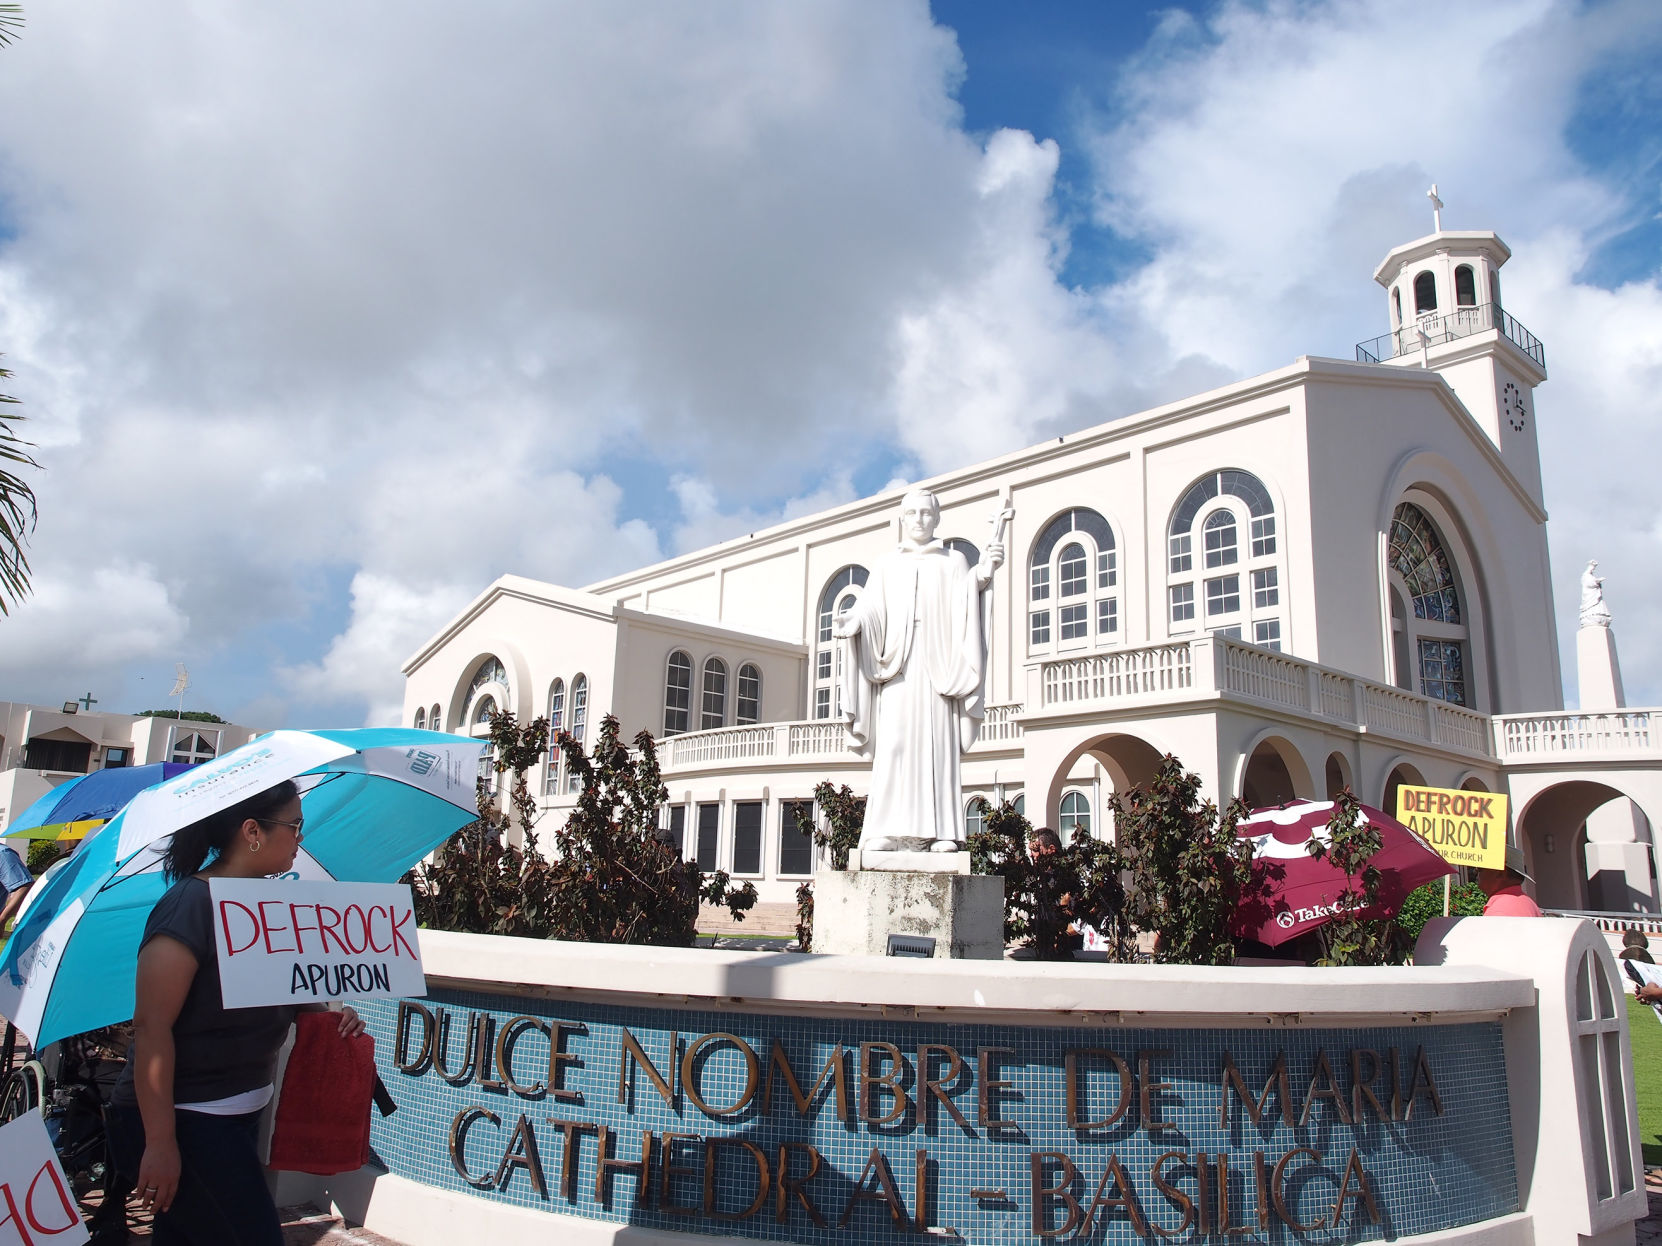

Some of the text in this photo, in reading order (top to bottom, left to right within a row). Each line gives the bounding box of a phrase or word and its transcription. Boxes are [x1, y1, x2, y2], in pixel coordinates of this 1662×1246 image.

[1403, 789, 1494, 820] DEFROCK
[1450, 850, 1483, 862] CHURCH
[219, 900, 418, 960] DEFROCK
[290, 962, 391, 996] APURON
[393, 1000, 1445, 1131] DULCE NOMBRE DE MARIA
[448, 1104, 955, 1237] CATHEDRAL
[1030, 1146, 1382, 1238] BASILICA
